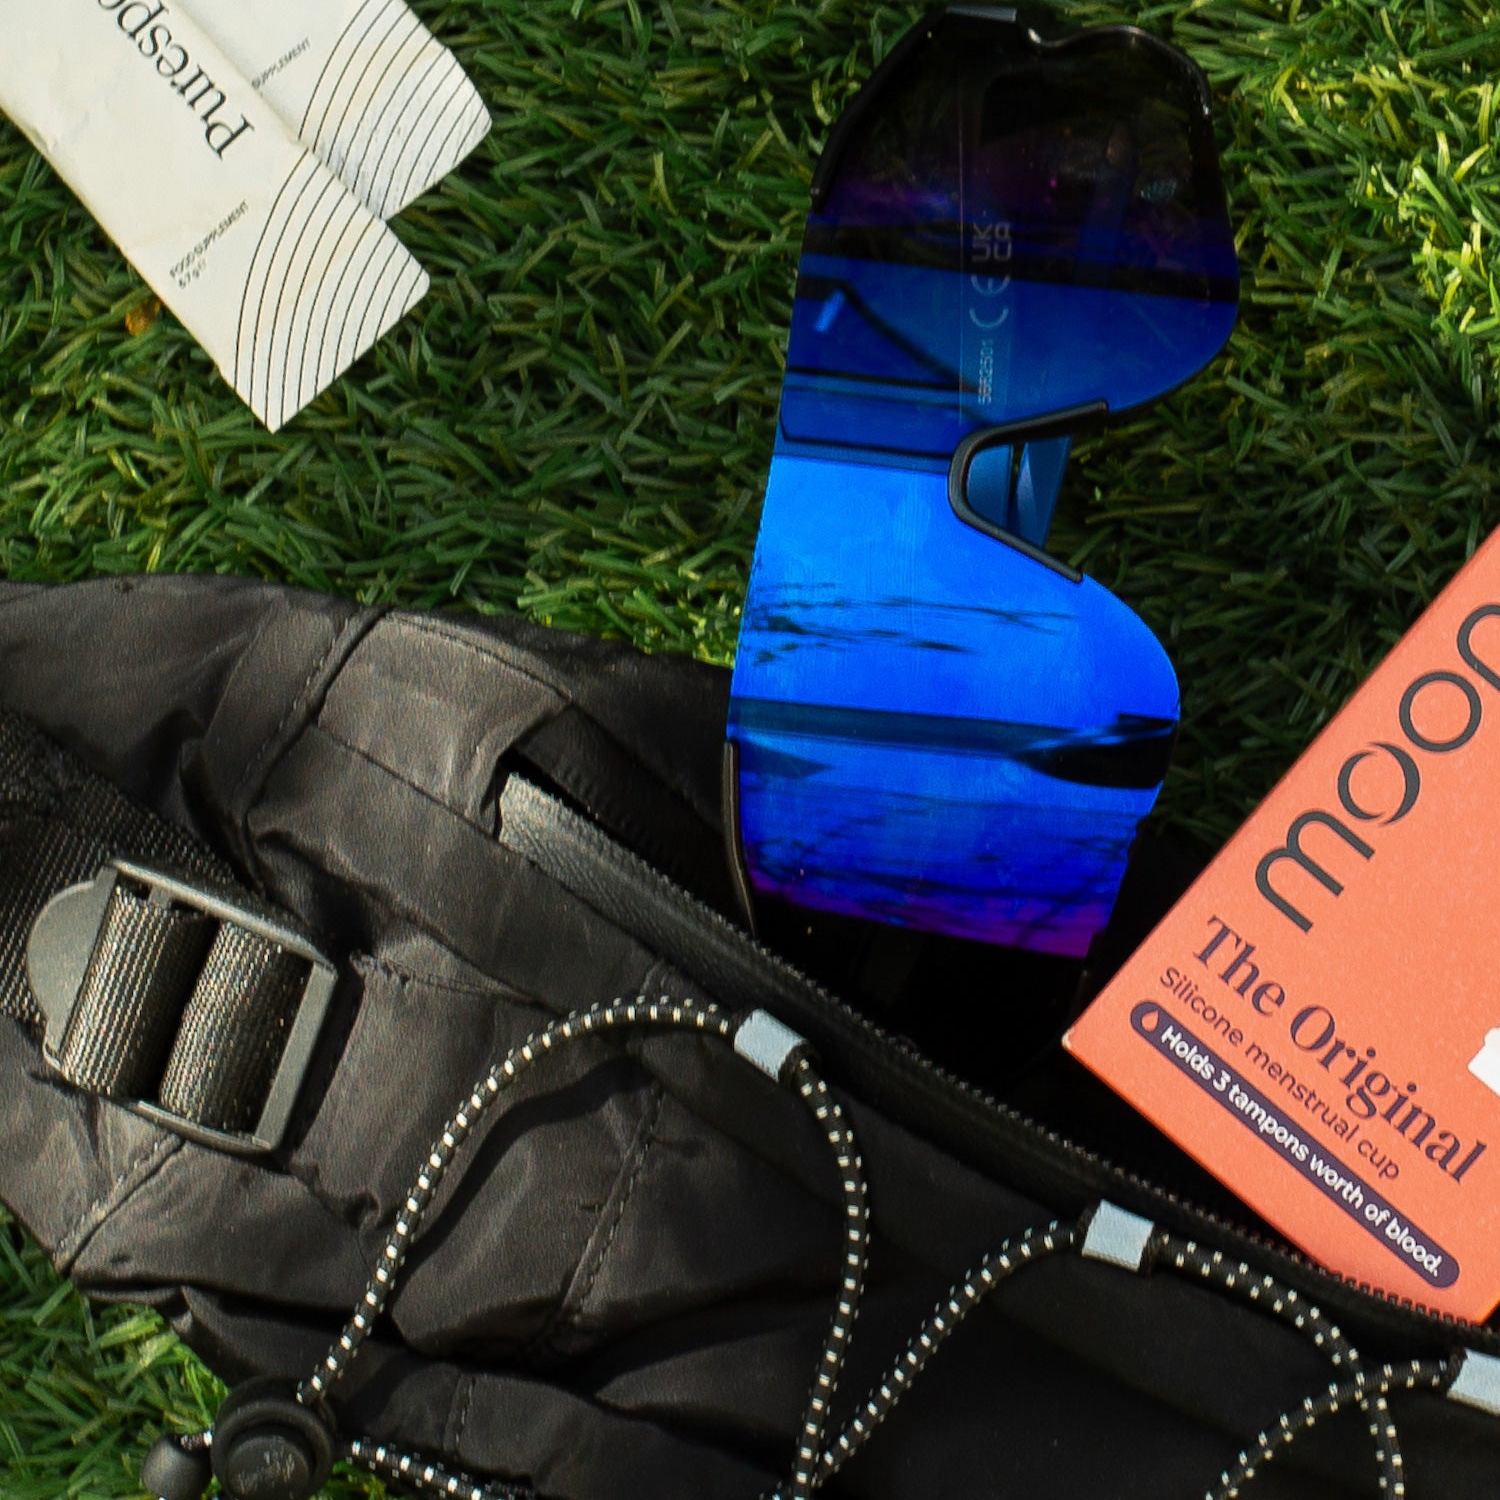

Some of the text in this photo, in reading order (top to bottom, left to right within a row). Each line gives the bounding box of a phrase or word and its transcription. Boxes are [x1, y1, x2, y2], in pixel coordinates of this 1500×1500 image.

[251, 37, 311, 90] SUPPLEMENT
[194, 200, 250, 255] SUPPLEMENT
[1159, 966, 1401, 1182] Silicone menstrual cup
[1160, 1024, 1444, 1276] Holds 3 tampons worth of blood.
[1193, 915, 1487, 1186] The Original
